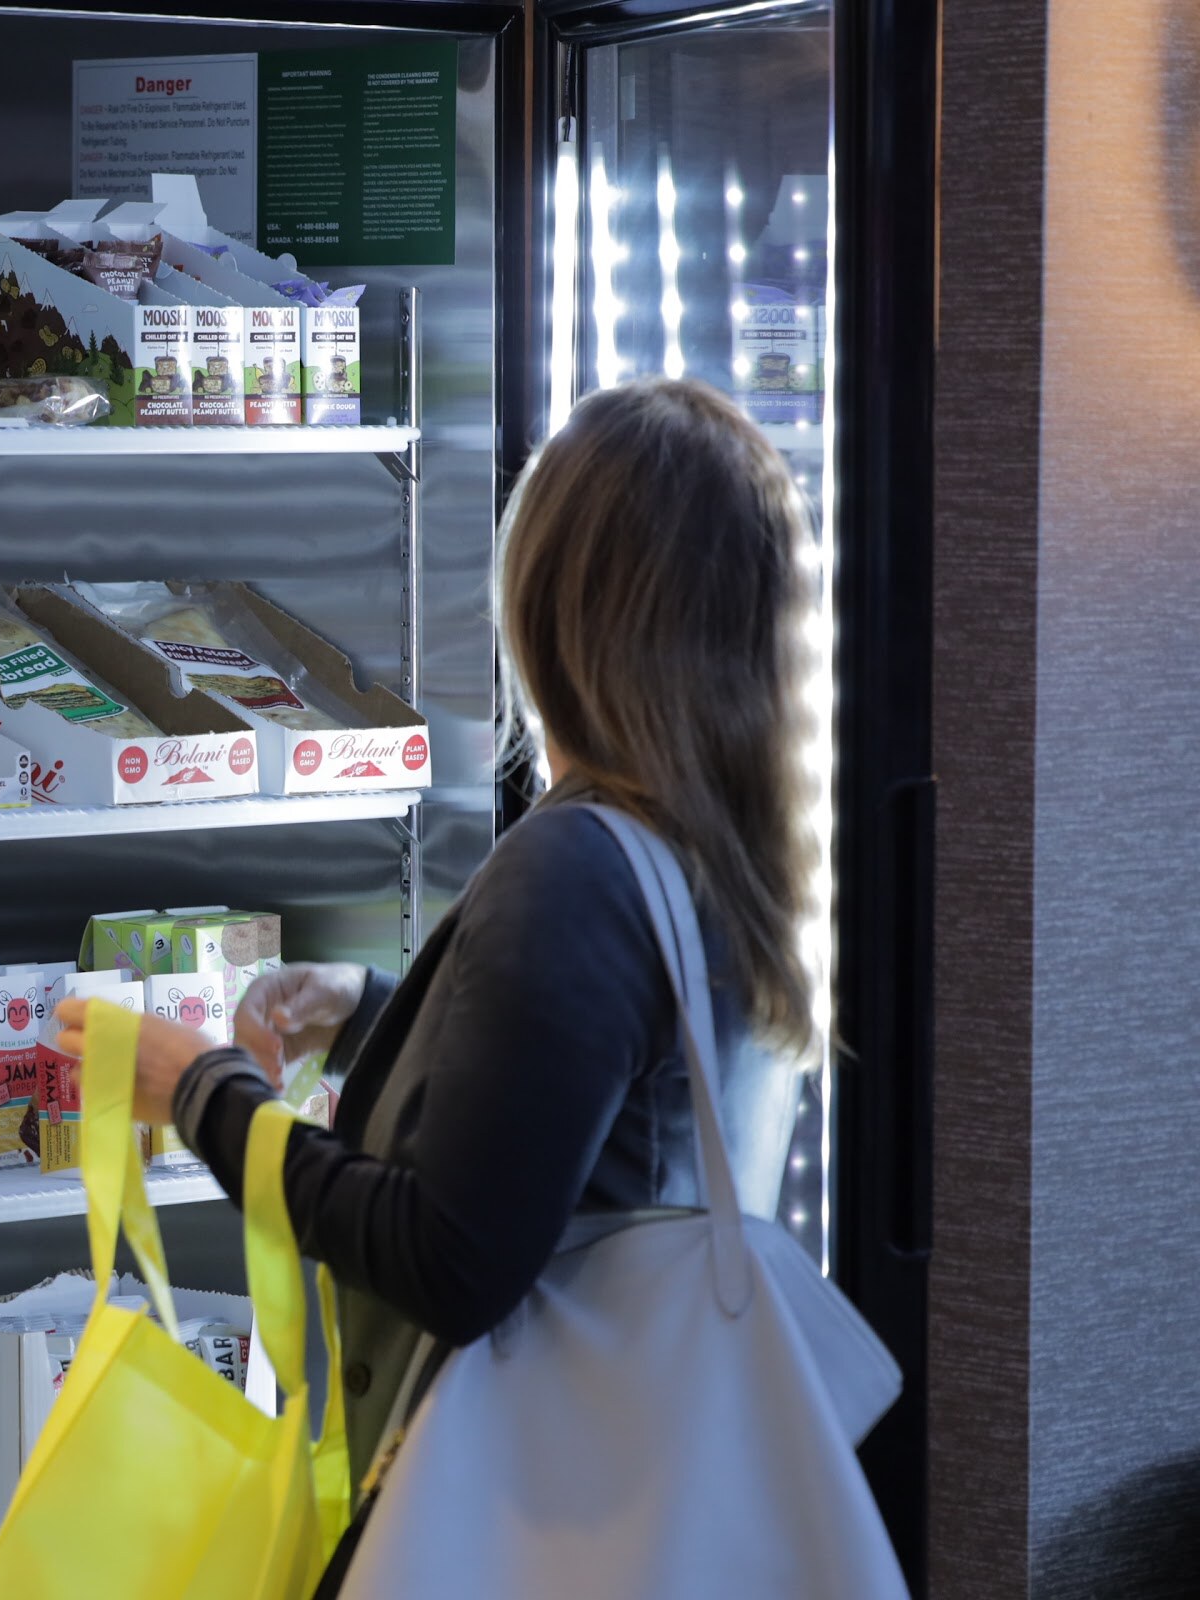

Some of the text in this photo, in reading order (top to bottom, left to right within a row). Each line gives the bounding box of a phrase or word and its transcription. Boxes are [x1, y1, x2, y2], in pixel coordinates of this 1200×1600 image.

[135, 76, 192, 95] Danger
[100, 271, 139, 279] CHOCOLATE
[109, 284, 135, 292] BUTTER
[254, 333, 274, 341] CHILLED
[284, 333, 293, 341] BAR
[316, 333, 335, 341] CHILLED
[158, 642, 241, 658] Spicy Potato
[9, 647, 47, 667] Filled
[166, 651, 249, 666] Filled Flatbread
[328, 733, 399, 760] Bolani
[406, 744, 425, 752] PLANT
[154, 739, 225, 767] Bolani
[232, 748, 251, 757] PLANT
[125, 757, 141, 765] NON
[232, 757, 251, 766] BASED
[124, 766, 141, 774] GMO
[17, 1038, 37, 1046] SNACK
[5, 1063, 37, 1082] JAM
[45, 1060, 56, 1103] JAM
